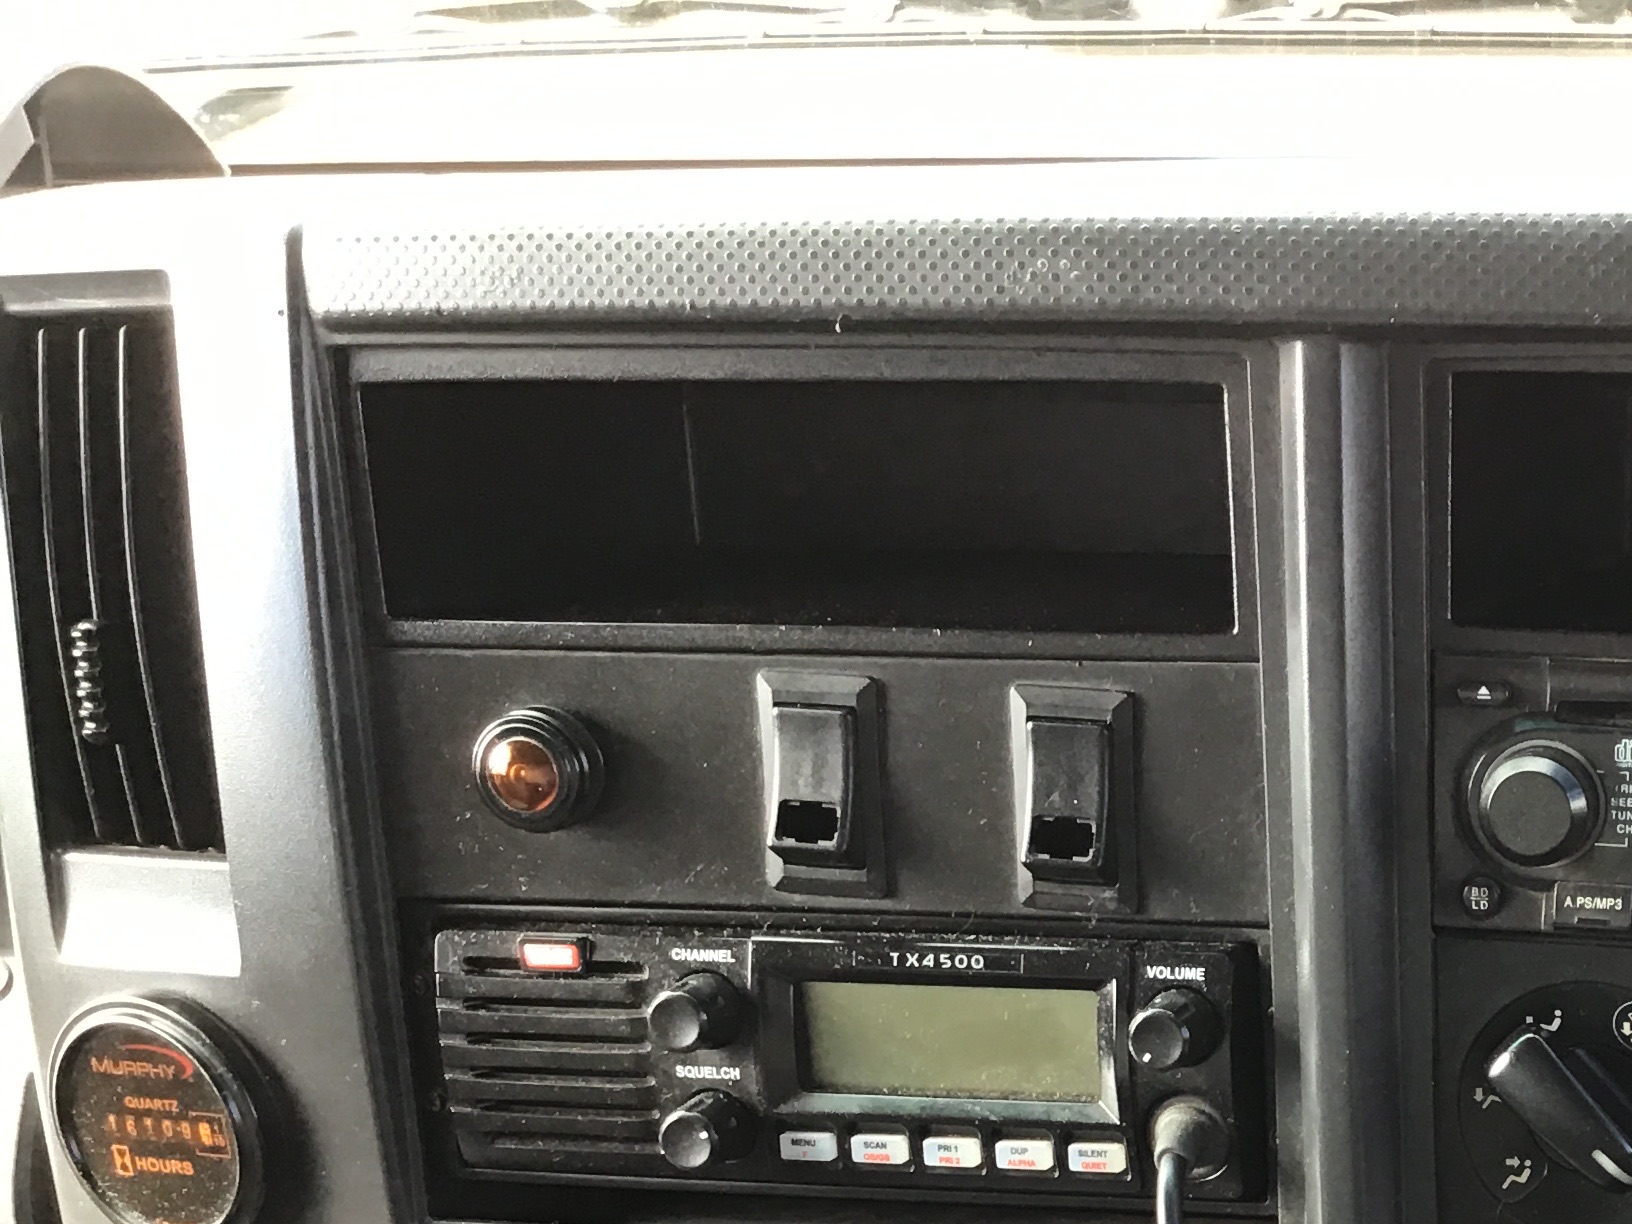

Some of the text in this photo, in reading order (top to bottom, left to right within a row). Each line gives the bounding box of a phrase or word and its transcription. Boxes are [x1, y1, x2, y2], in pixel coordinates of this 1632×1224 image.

[1471, 887, 1489, 898] BD
[1471, 900, 1489, 910] LD
[671, 947, 736, 963] CHANNEL
[889, 952, 986, 970] TX4500
[1146, 965, 1206, 981] VOLUME
[90, 1056, 176, 1079] MURPHY
[675, 1064, 741, 1081] SQUELCH
[124, 1096, 180, 1112] QUARTZ
[791, 1138, 816, 1147] MENU
[863, 1141, 888, 1150] SCAN
[937, 1145, 951, 1153] PRI
[1010, 1147, 1029, 1156] DUP
[1077, 1149, 1108, 1159] SILENT
[135, 1156, 194, 1176] HOURS
[1007, 1159, 1037, 1168] ALPHA
[1081, 1162, 1108, 1171] QUIET
